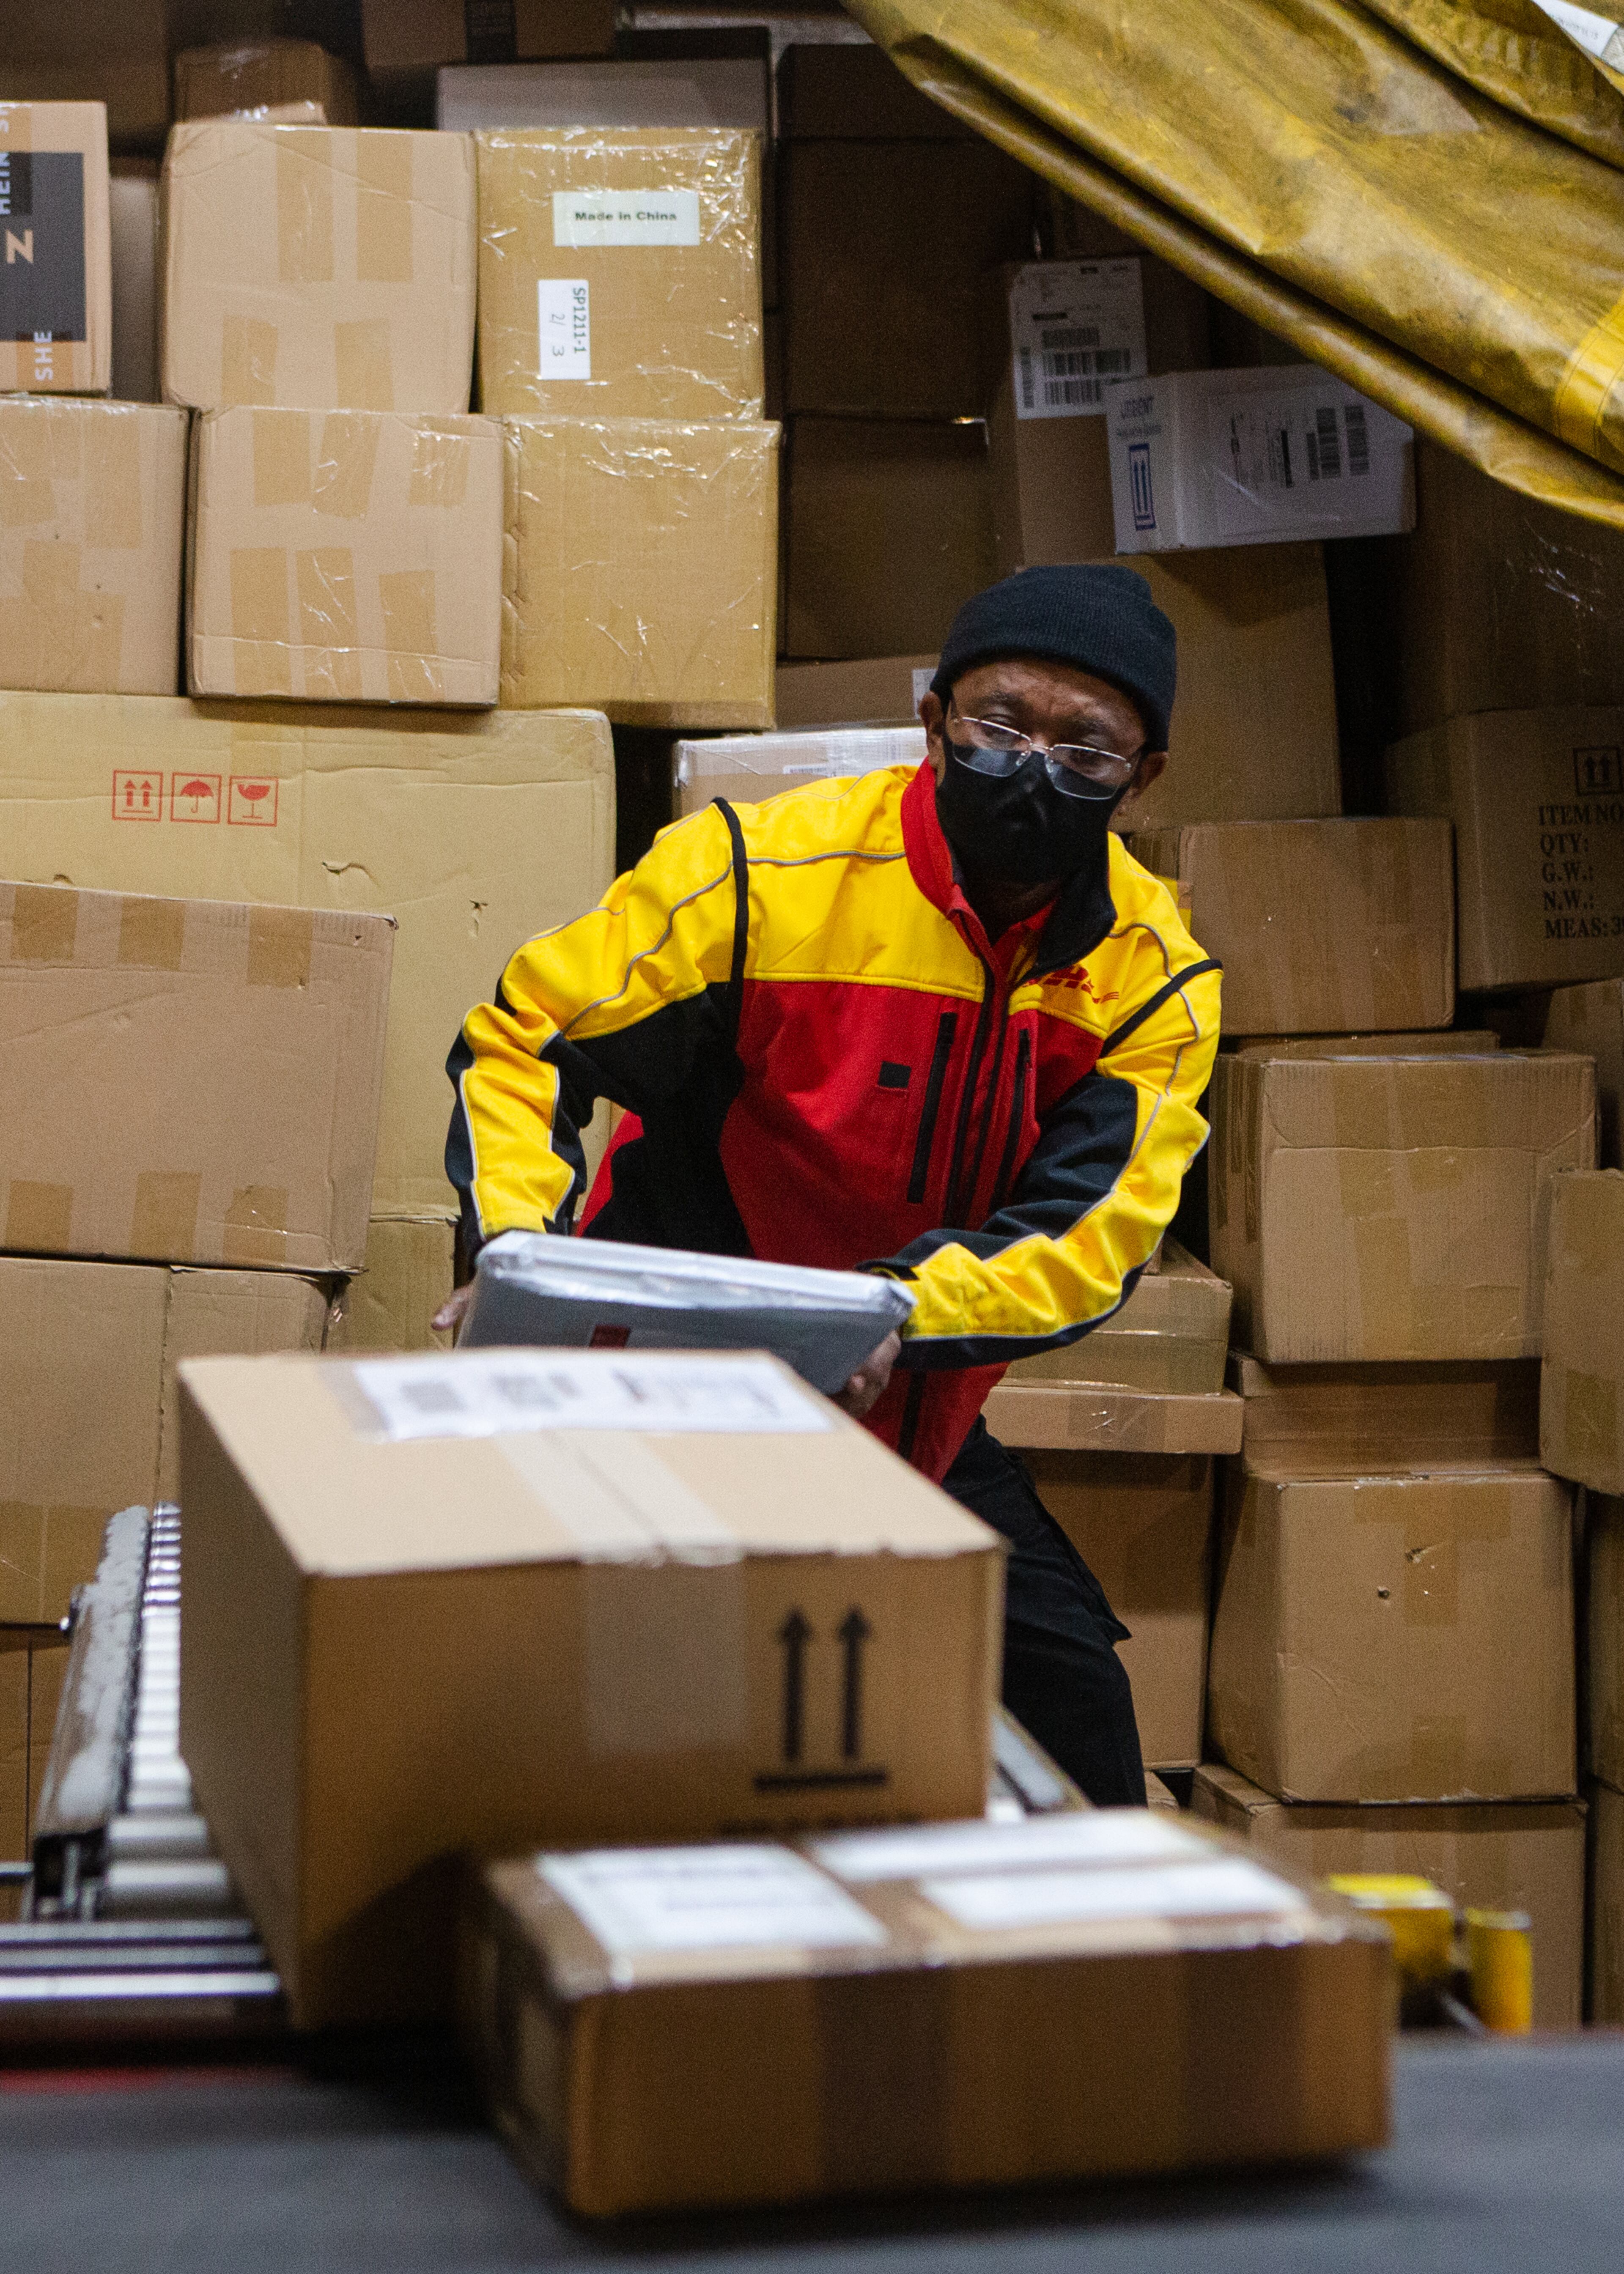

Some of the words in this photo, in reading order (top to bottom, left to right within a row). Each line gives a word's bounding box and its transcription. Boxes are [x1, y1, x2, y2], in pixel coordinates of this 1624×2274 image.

[575, 212, 613, 221] Made
[619, 211, 631, 220] in
[636, 211, 677, 221] China
[573, 287, 587, 354] SP1211-1
[33, 331, 54, 381] SHE
[552, 345, 564, 357] 3
[1539, 804, 1590, 826] ITEM
[1540, 833, 1589, 857] QTY:
[1543, 861, 1594, 883] G.W.:
[1544, 889, 1594, 910] N.W.:
